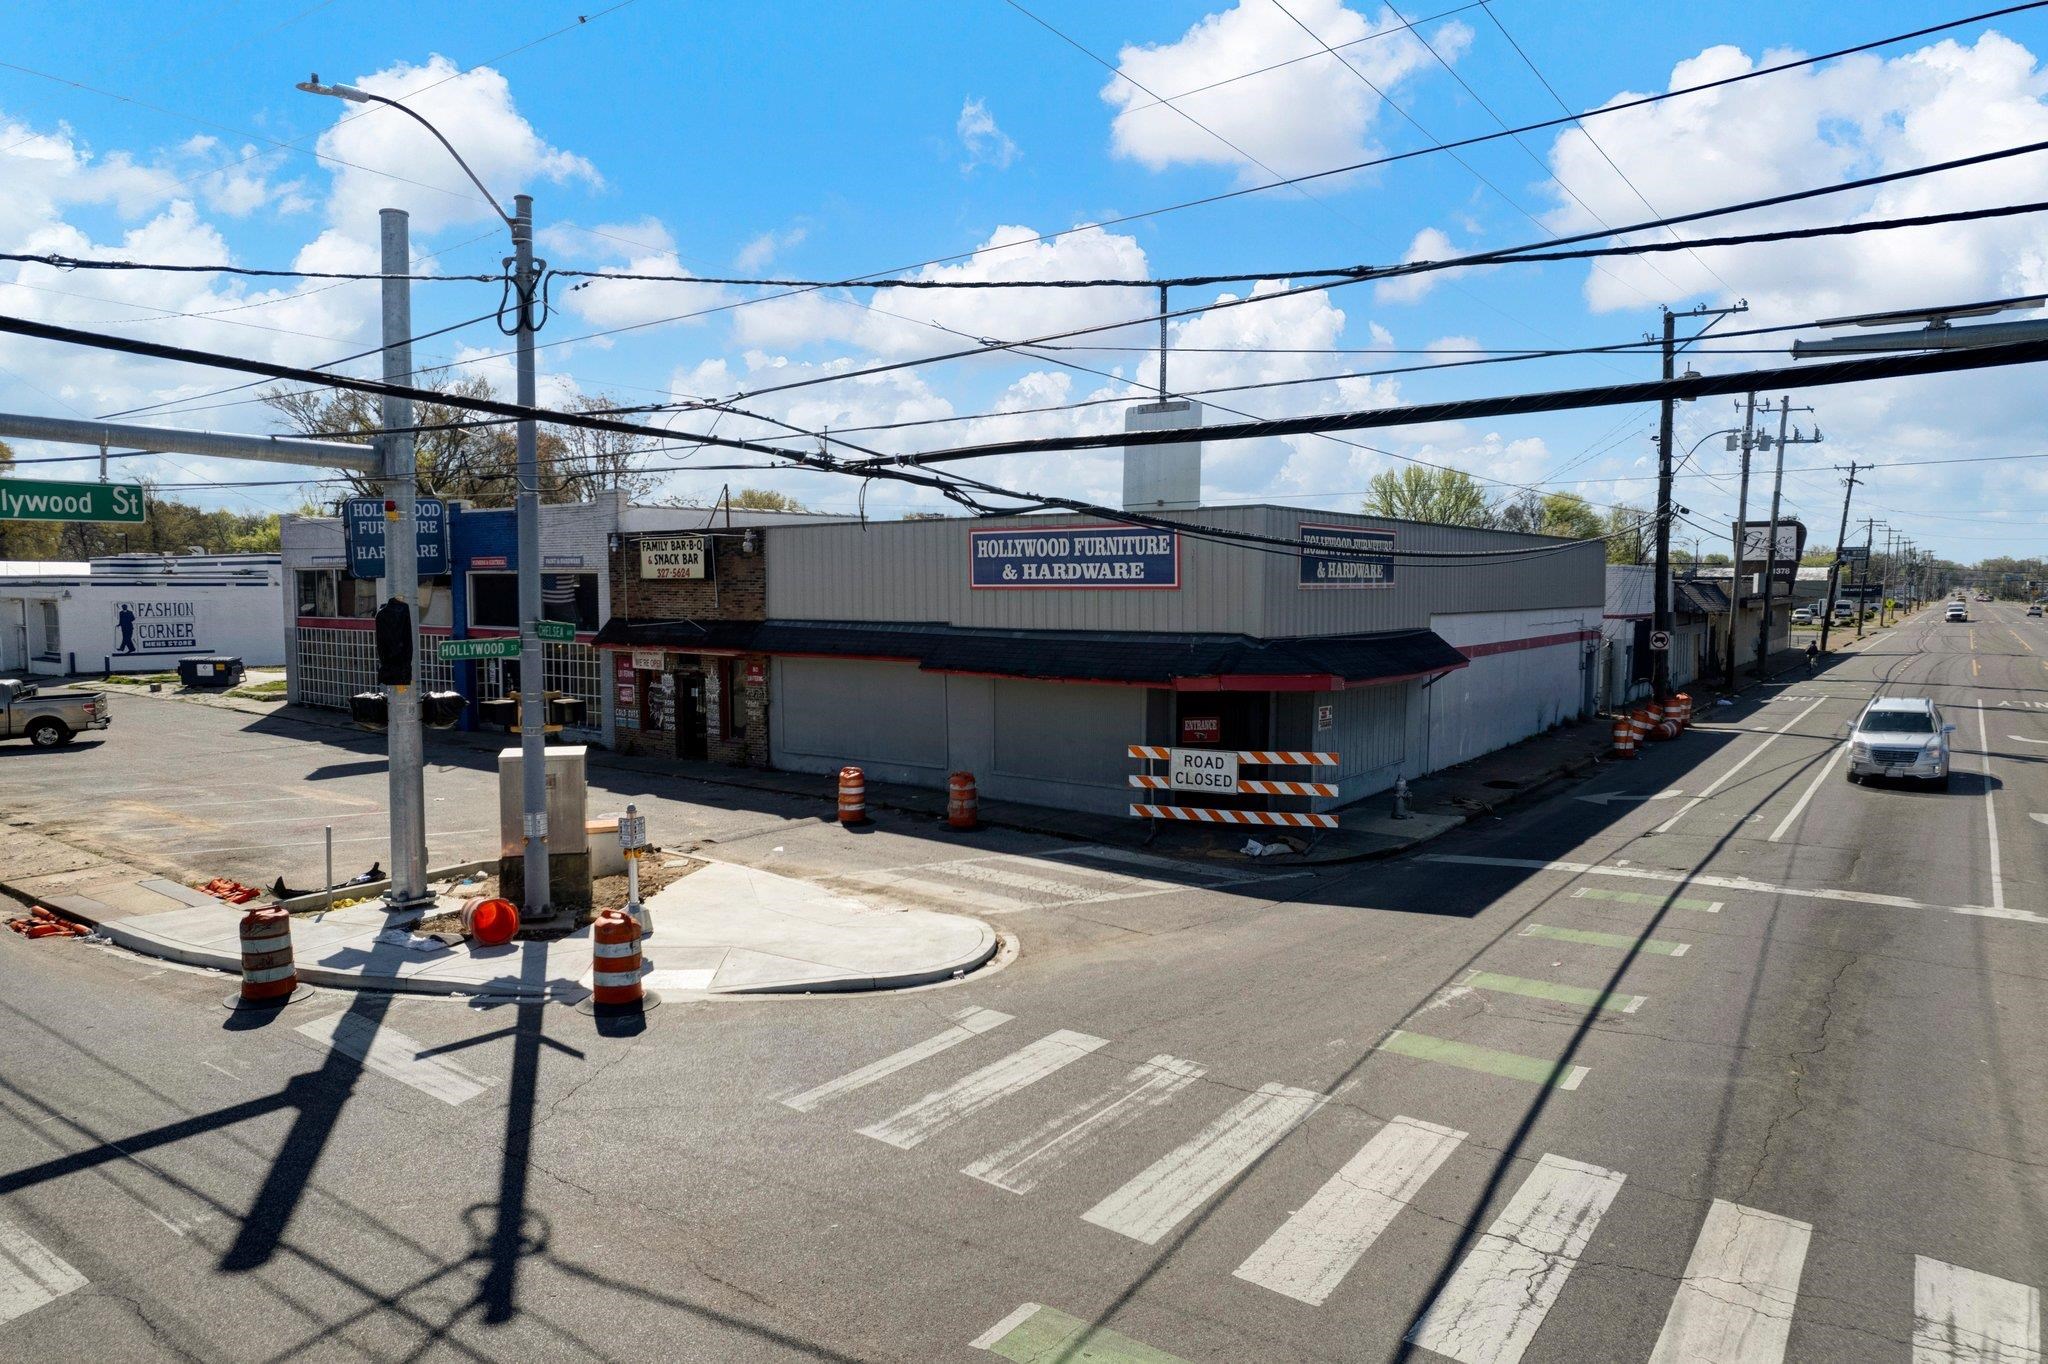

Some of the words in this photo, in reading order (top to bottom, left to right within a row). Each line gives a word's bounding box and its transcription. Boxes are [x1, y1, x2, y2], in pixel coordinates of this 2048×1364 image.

[112, 486, 139, 515] St
[353, 503, 440, 517] HOLLOOD
[642, 541, 668, 552] FAMILY
[977, 538, 1070, 558] HOLLYWOOD
[1073, 535, 1170, 556] FURNITURE
[648, 556, 653, 565] &
[654, 553, 680, 565] SNACK
[682, 553, 699, 565] BAR
[657, 568, 691, 578] 327-5624
[1002, 564, 1018, 580] &
[1022, 562, 1145, 580] HARDWARE
[1317, 561, 1326, 578] &
[1327, 562, 1383, 578] HARDWARE
[138, 602, 194, 617] FASHION
[139, 623, 194, 638] CORNER
[539, 624, 564, 637] CHELSEA
[441, 643, 505, 657] HOLLYWOOD
[1184, 719, 1218, 731] ENTRANCE
[1184, 755, 1224, 769] ROAD
[1175, 771, 1232, 788] CLOSED
